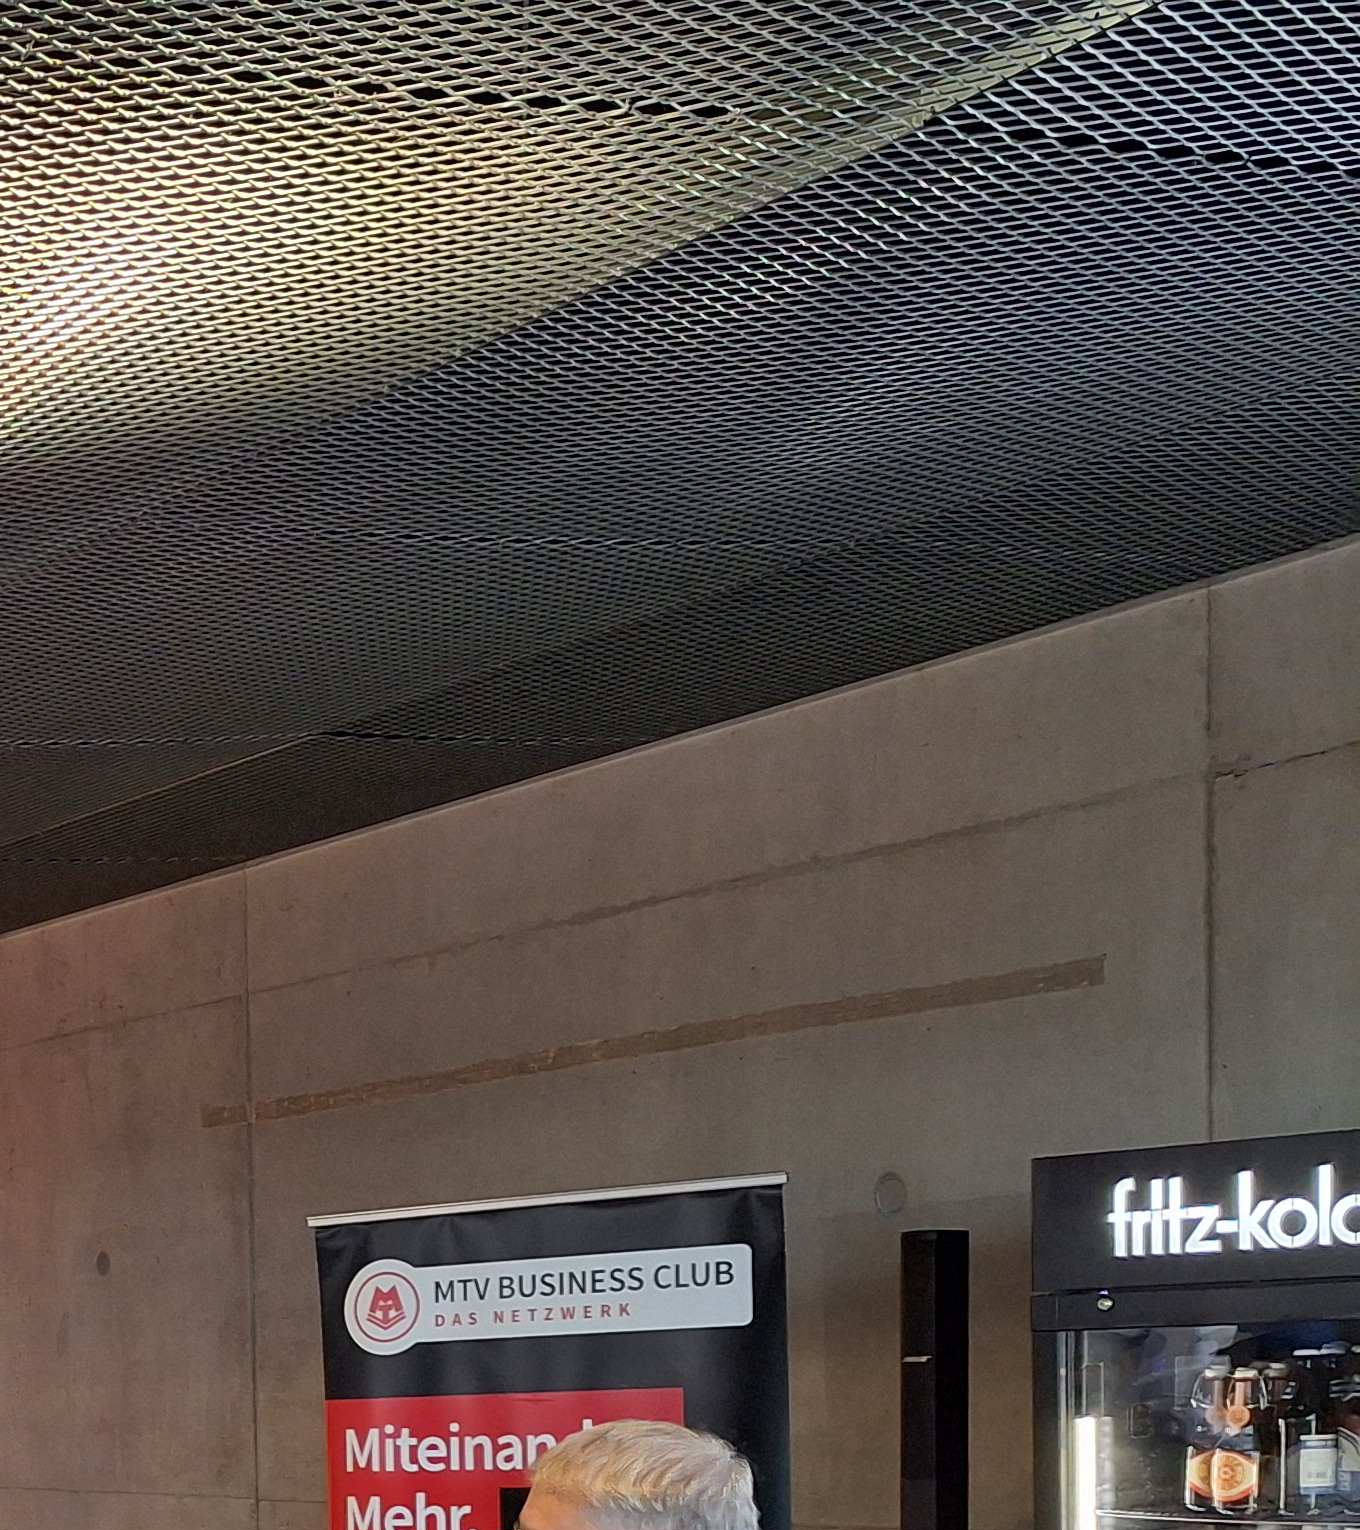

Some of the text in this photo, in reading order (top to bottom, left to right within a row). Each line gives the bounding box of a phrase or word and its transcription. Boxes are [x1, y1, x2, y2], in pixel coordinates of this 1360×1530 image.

[434, 1261, 735, 1304] MTV BUSINESS CLUB
[434, 1302, 631, 1327] DAS NETZWERK
